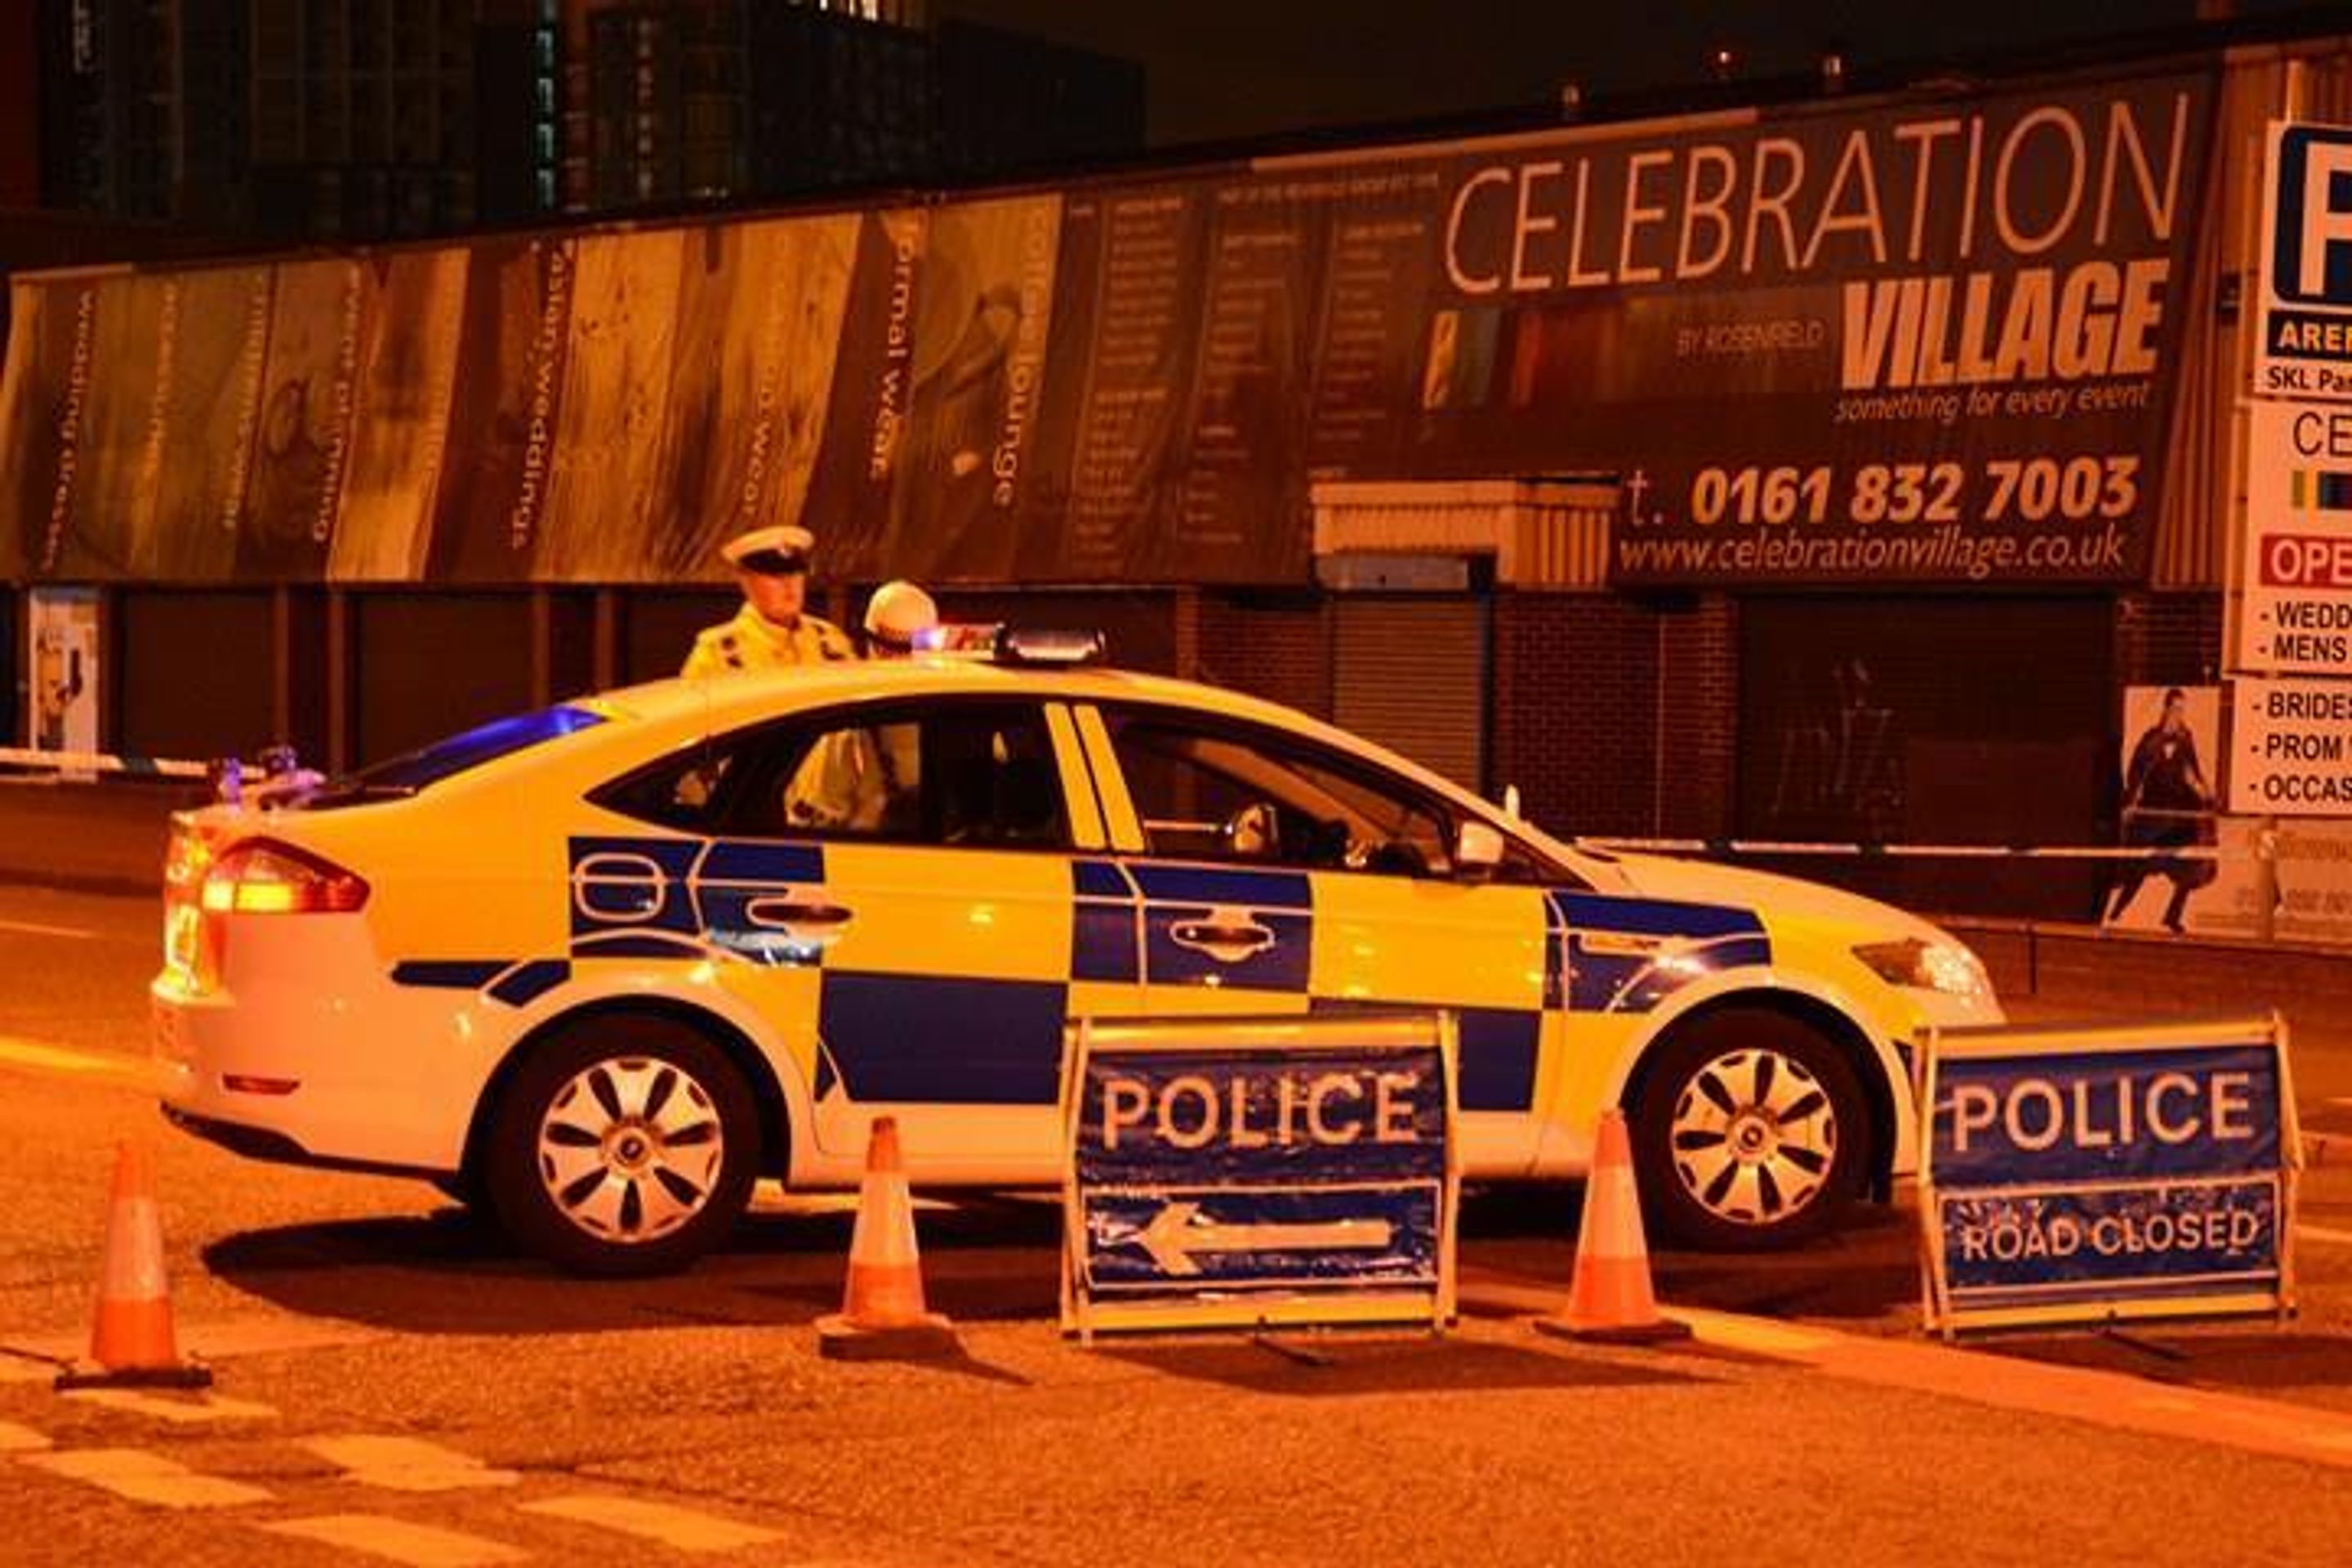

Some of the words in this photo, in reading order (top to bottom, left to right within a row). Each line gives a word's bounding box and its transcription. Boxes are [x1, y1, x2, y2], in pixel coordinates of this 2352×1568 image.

[1446, 93, 2189, 295] CELEBRATION
[1842, 260, 2171, 392] VILLAGE
[1834, 390, 1959, 425] something
[1965, 385, 2003, 417] for
[2005, 385, 2075, 421] every
[2077, 381, 2149, 412] event
[2268, 367, 2310, 390] SKL
[869, 363, 904, 483] wear
[992, 351, 1039, 507] lounge
[512, 361, 558, 550] weddings
[1691, 468, 1833, 525] 0161
[1850, 463, 1965, 524] 832
[1984, 457, 2141, 520] 7003
[1619, 523, 2125, 580] www.celebrationvillage.co.uk
[2272, 539, 2352, 582] OPE
[2276, 601, 2352, 629] WEDD
[2274, 634, 2348, 663] MENS
[2267, 692, 2352, 719] BRIDE
[2267, 733, 2343, 763] PROM
[1102, 1071, 1421, 1150] POLICE
[1953, 1072, 2255, 1152] POLICE
[1962, 1216, 2081, 1261] ROAD
[2091, 1209, 2259, 1256] CLOSED
